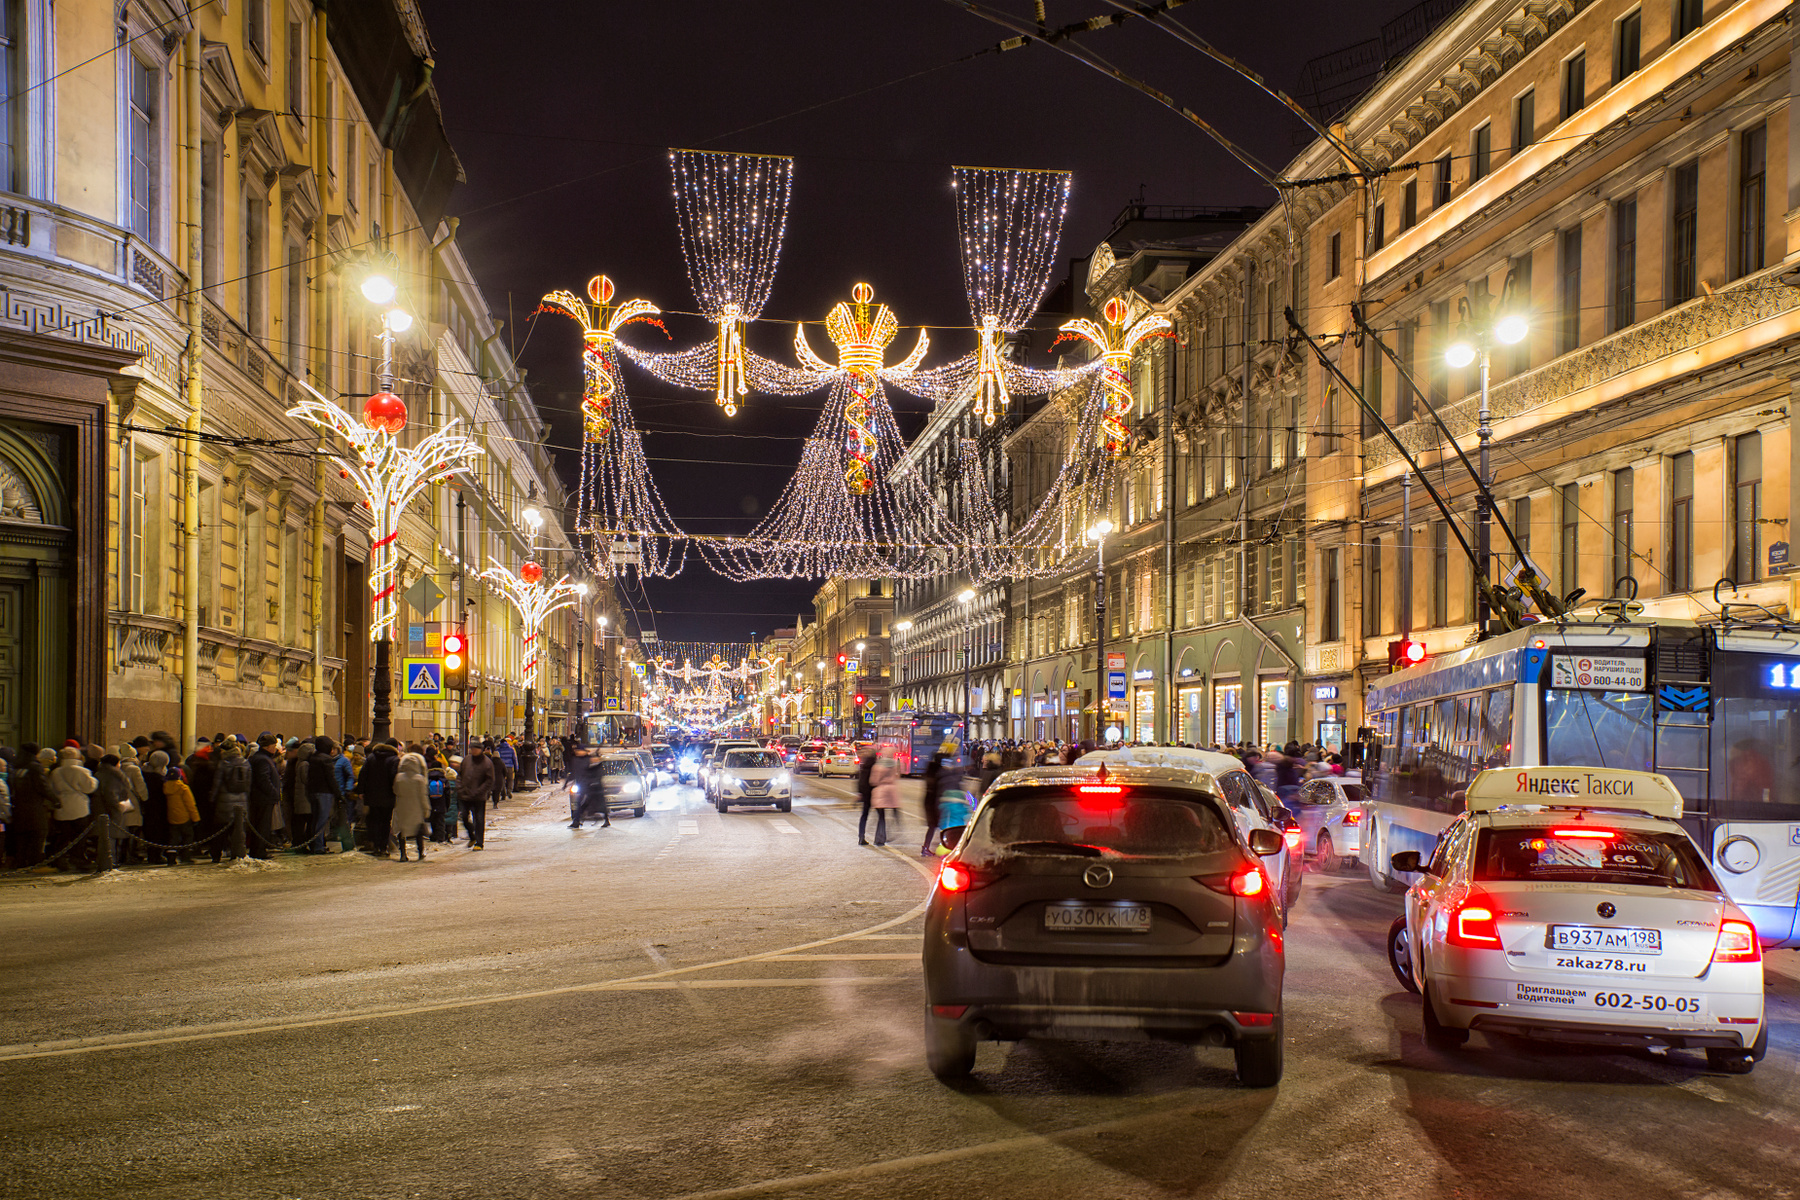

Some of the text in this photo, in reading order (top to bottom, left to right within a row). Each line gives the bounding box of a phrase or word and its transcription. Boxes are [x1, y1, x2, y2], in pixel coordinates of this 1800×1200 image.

[1593, 675, 1641, 687] 600-44-00
[1516, 772, 1633, 796] Яндекс Такси
[1609, 841, 1653, 853] Такси
[1121, 907, 1148, 922] 178
[1559, 930, 1656, 947] В937АМ 198
[1556, 956, 1647, 973] zakaz78.ru
[1517, 983, 1587, 998] Приглашаем
[1516, 993, 1576, 1005] водителей
[1594, 992, 1700, 1013] 602-50-05
